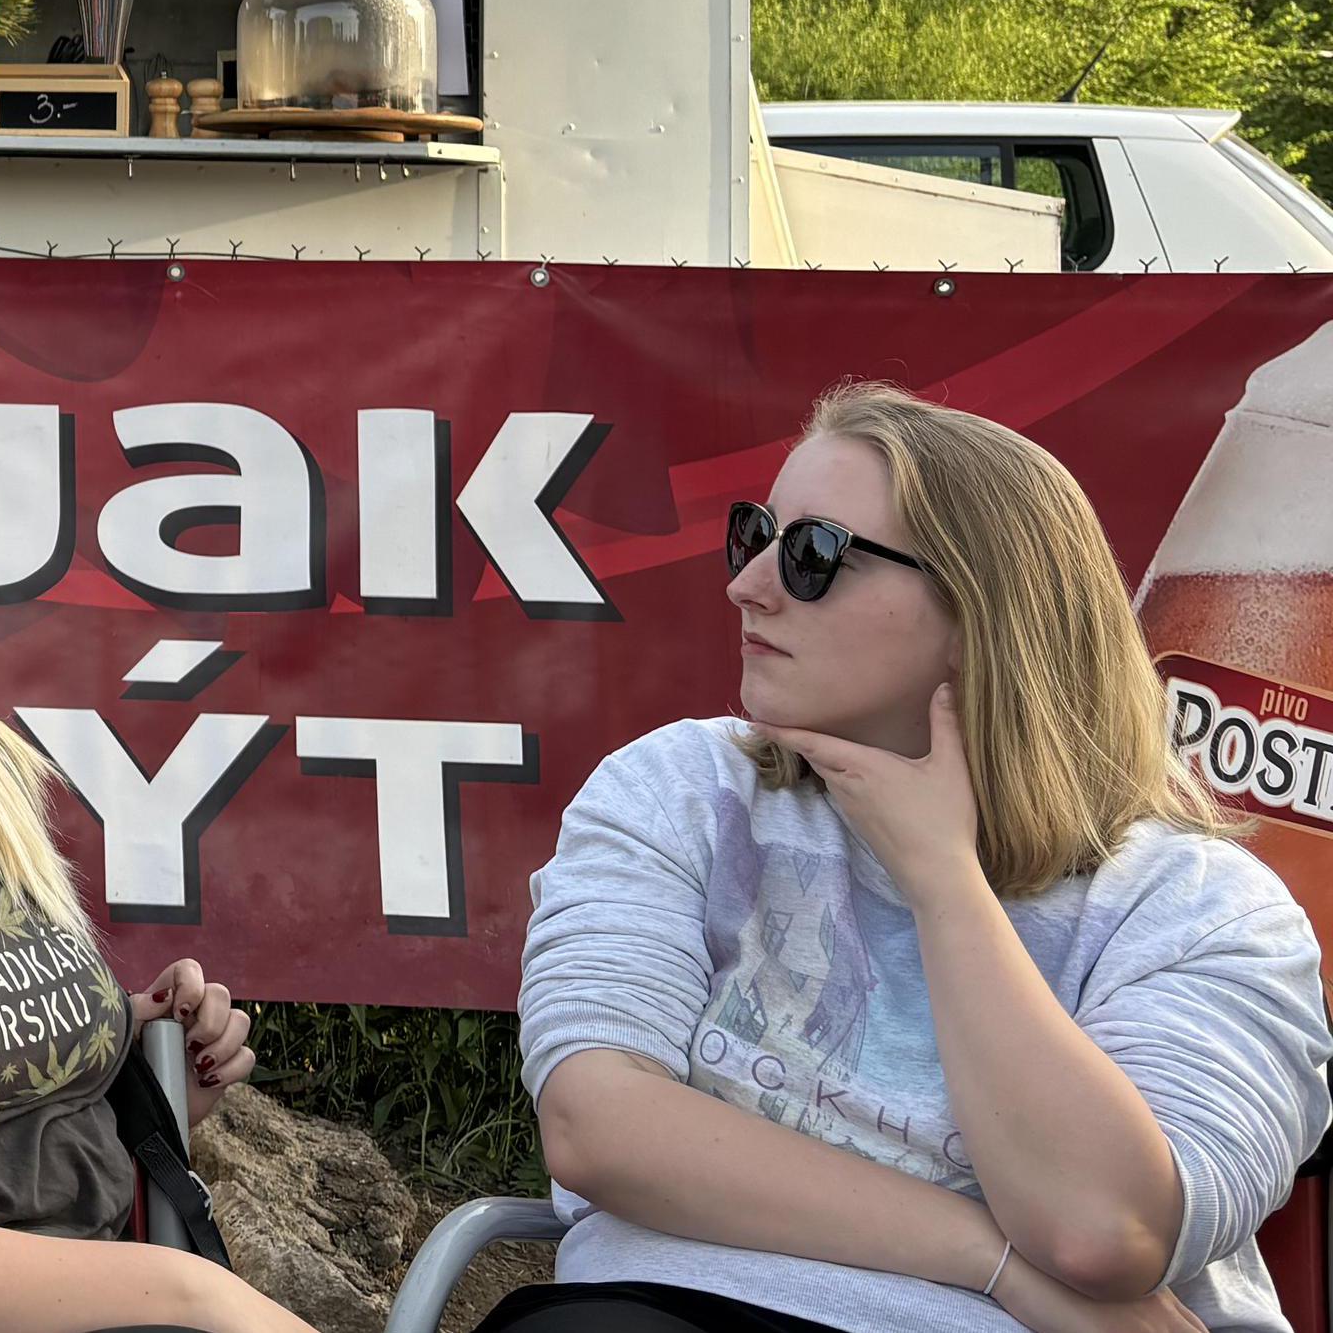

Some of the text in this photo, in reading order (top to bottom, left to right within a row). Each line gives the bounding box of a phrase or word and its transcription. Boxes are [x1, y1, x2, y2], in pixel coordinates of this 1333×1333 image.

[1171, 689, 1333, 811] POST
[1259, 685, 1309, 722] pivo
[12, 638, 528, 921] ÝT
